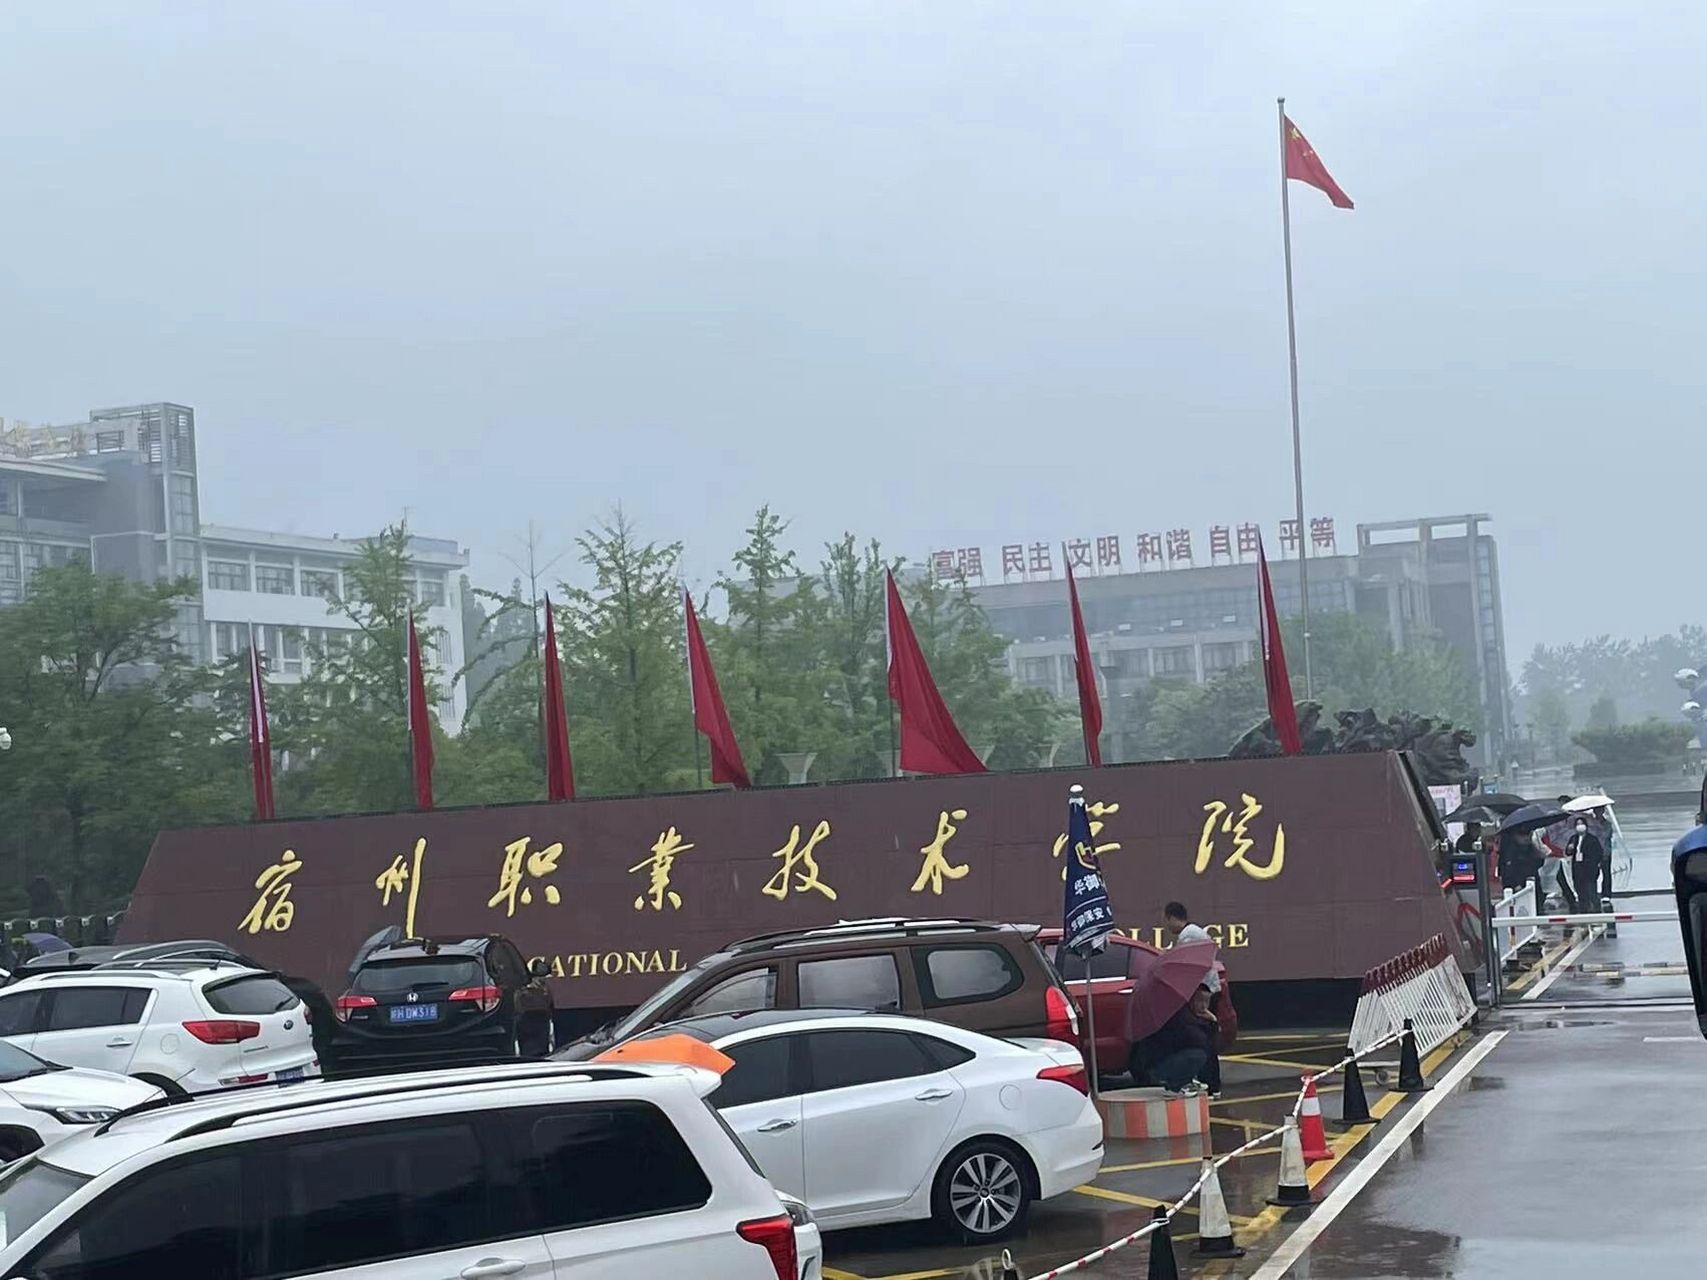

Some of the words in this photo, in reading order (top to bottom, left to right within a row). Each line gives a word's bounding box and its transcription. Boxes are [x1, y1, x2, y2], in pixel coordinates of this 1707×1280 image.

[932, 546, 982, 581] 富强
[1002, 541, 1053, 576] 民主
[1067, 535, 1121, 569] 文明
[1137, 528, 1193, 563] 和谐
[1209, 522, 1260, 557] 自由
[1279, 516, 1334, 551] 平等
